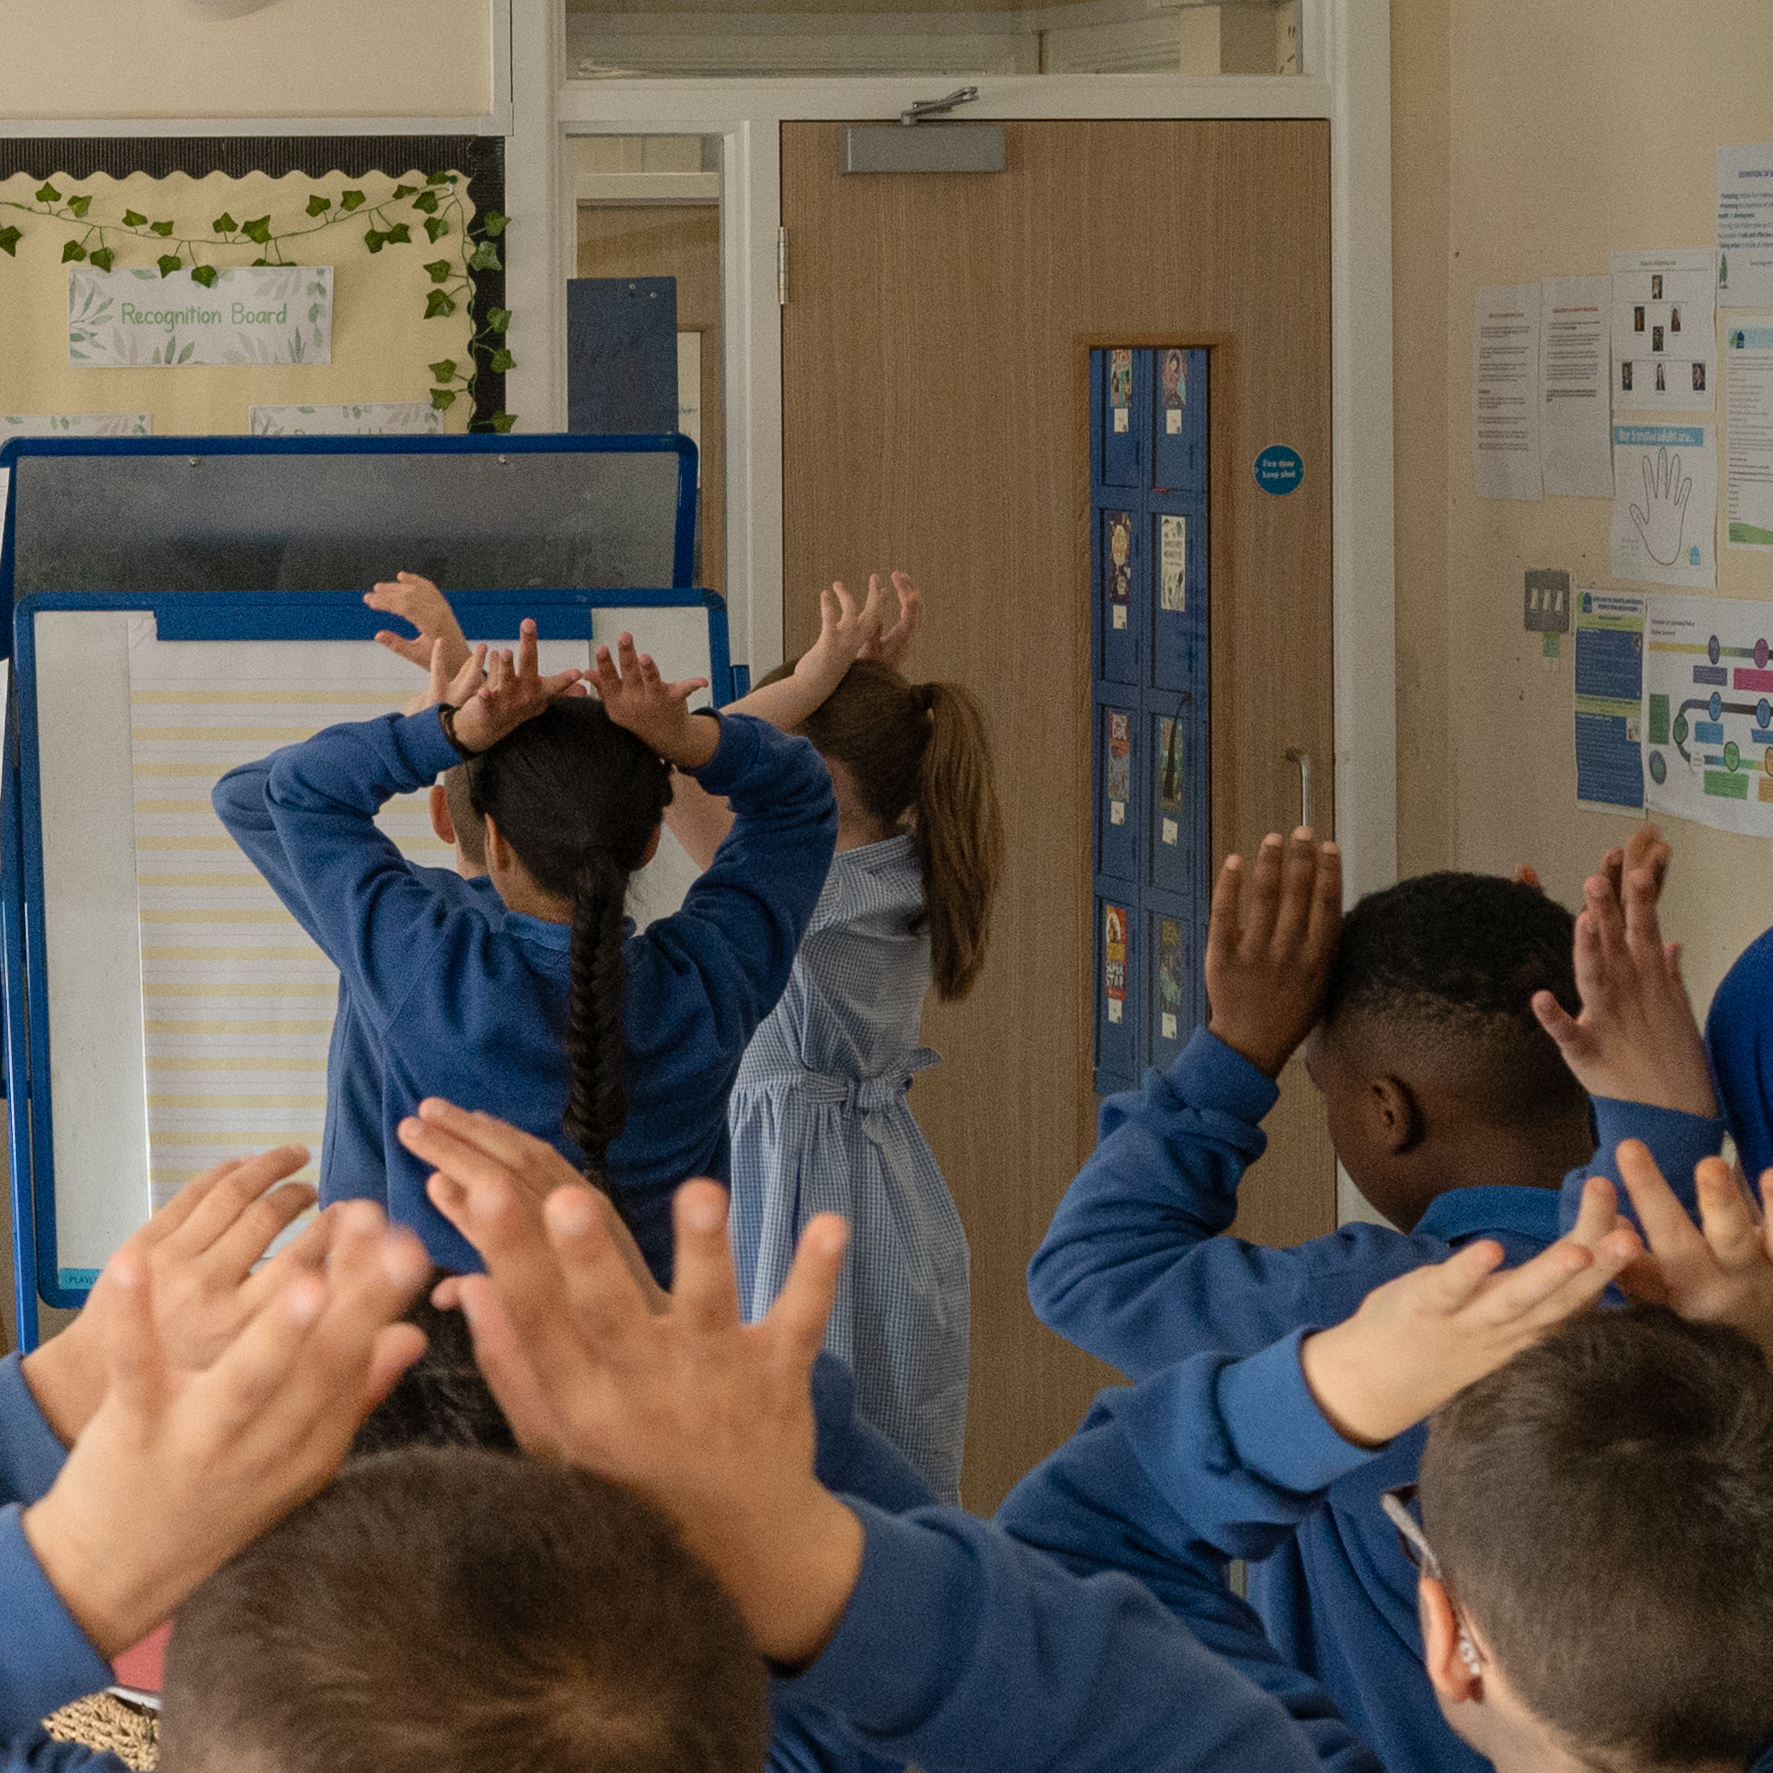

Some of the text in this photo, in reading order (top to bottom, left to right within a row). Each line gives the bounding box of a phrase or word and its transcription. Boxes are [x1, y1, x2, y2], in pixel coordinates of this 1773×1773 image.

[121, 302, 287, 333] Recognition Board
[1263, 459, 1295, 468] Fire door
